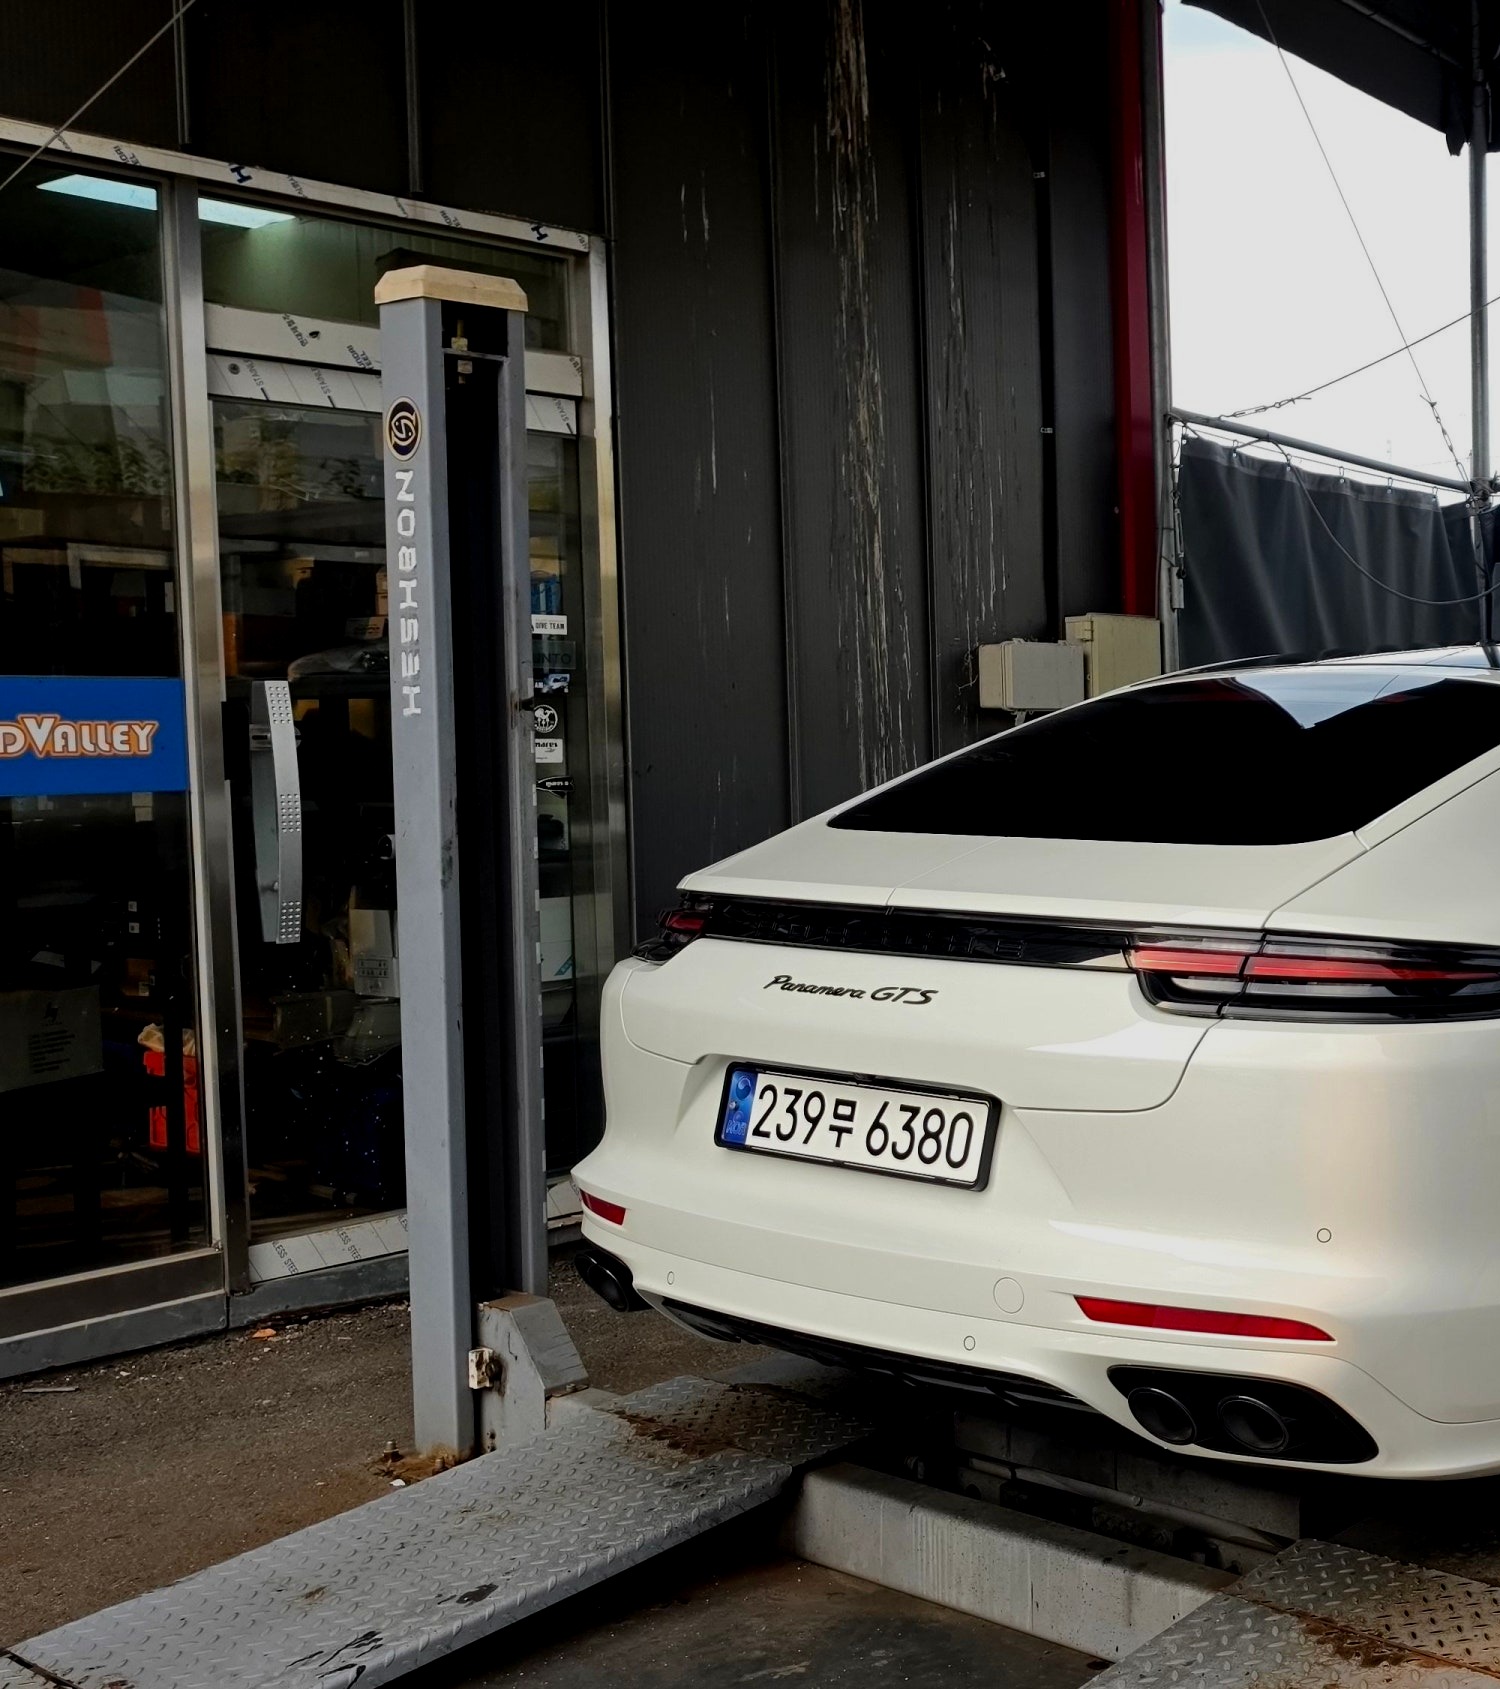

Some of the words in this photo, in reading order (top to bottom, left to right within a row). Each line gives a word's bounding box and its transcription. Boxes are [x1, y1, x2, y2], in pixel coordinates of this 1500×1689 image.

[395, 469, 422, 717] HESHBON
[763, 975, 867, 999] Panamera
[870, 987, 939, 1005] GTS
[752, 1084, 857, 1148] 239무
[865, 1101, 974, 1169] 6380
